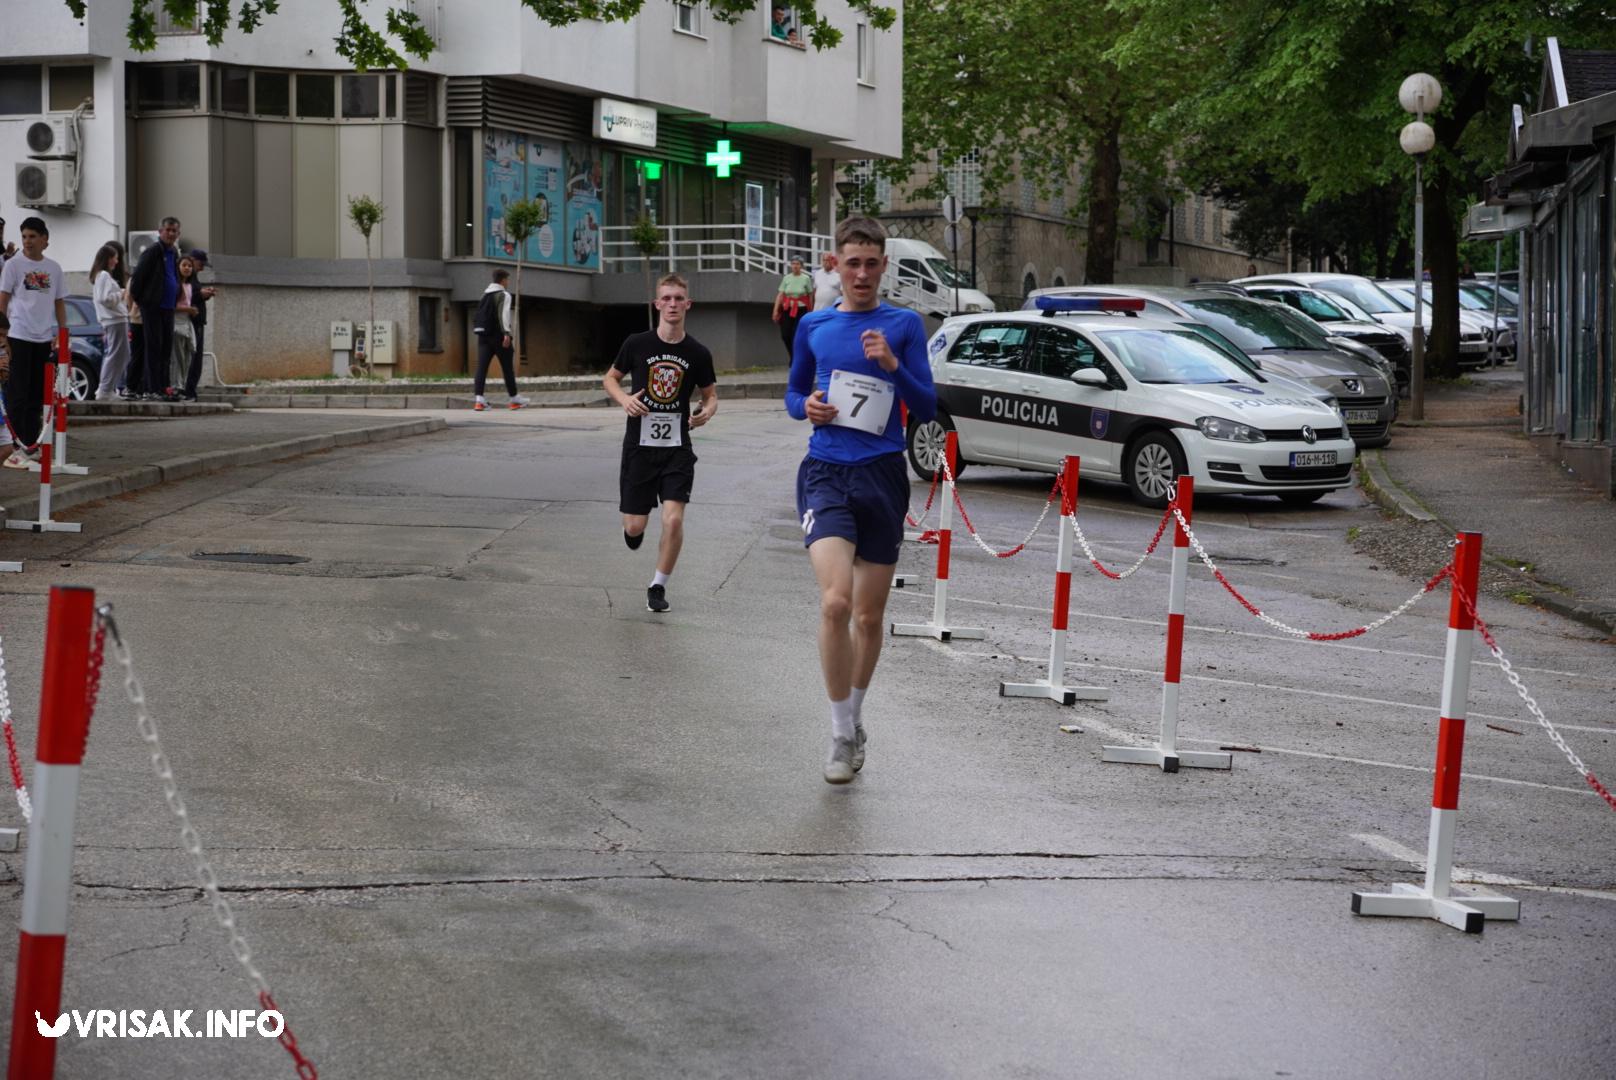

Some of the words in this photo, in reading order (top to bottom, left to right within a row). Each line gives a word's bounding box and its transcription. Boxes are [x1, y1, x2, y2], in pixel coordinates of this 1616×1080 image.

[662, 354, 690, 370] BRIGADA
[850, 392, 869, 418] 7
[980, 395, 1059, 426] POLICIJA
[650, 423, 672, 440] 32
[1296, 453, 1336, 466] 016-M-118
